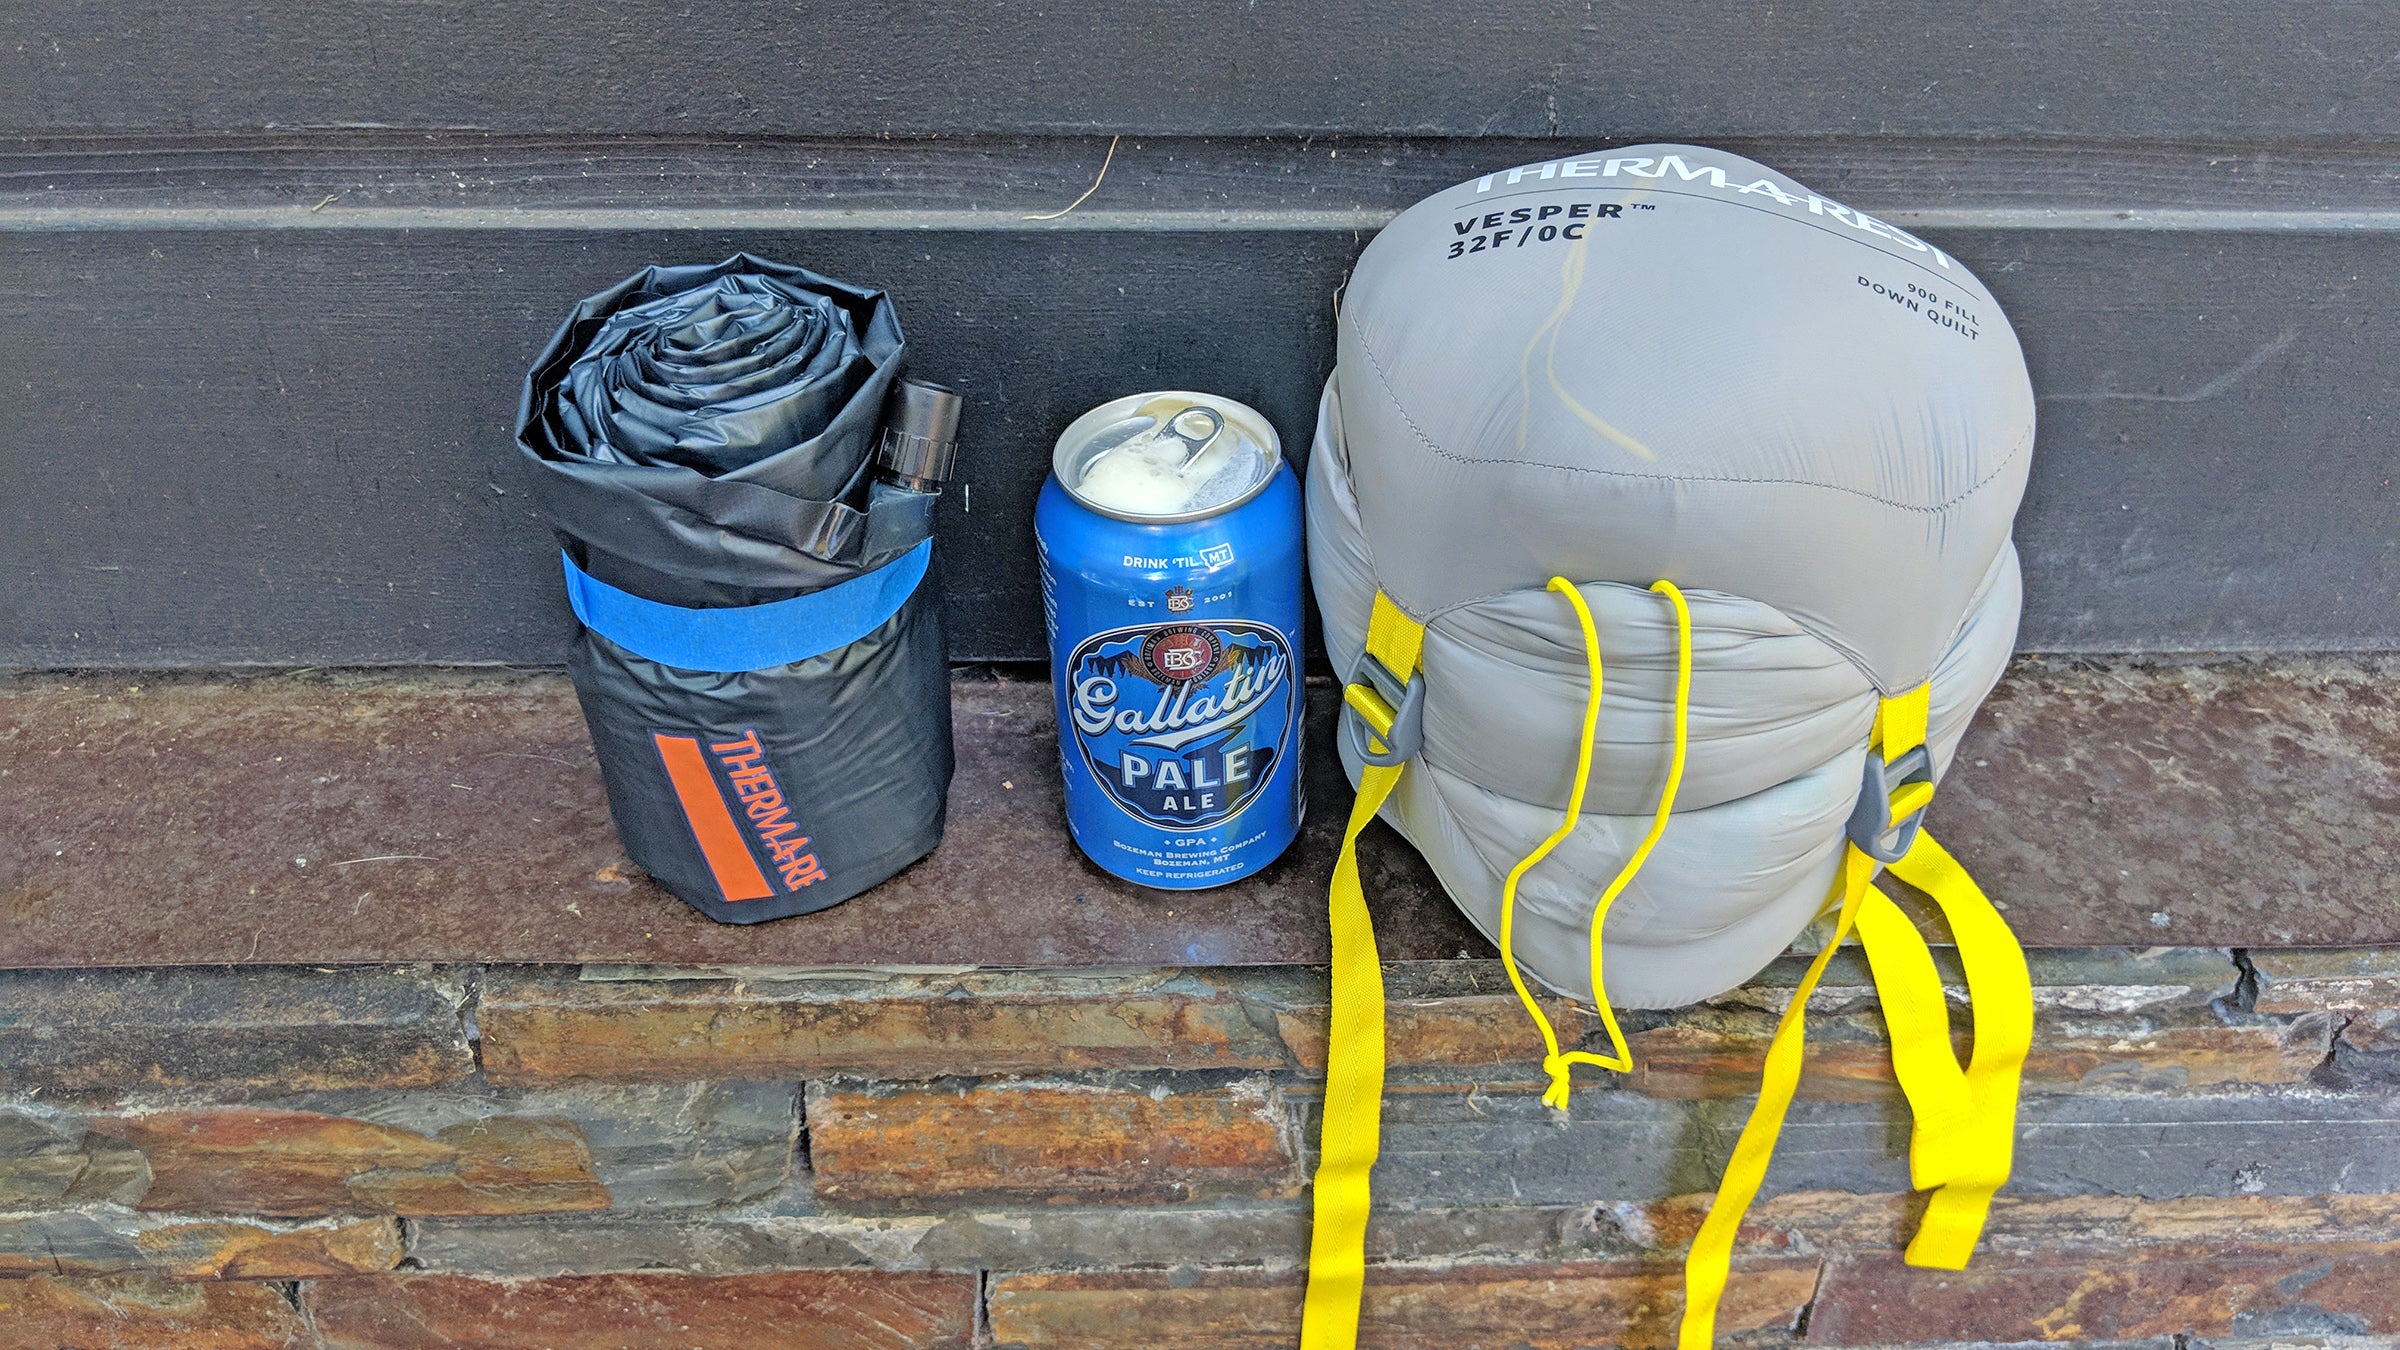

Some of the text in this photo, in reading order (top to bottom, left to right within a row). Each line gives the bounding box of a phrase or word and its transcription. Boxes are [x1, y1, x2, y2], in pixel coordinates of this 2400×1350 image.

[1448, 223, 1586, 259] 32F/0C
[1857, 275, 1979, 341] DOWN QUILT
[1907, 283, 1980, 326] 900 FILL
[1123, 555, 1168, 569] DRINK
[1207, 550, 1229, 565] MT
[1128, 591, 1233, 608] EST 2001
[1073, 653, 1288, 736] Gallatin
[1120, 742, 1251, 791] PALE
[1162, 793, 1215, 811] ALE
[1113, 830, 1267, 859] BOZEMAN BREWING COMPANY
[1175, 837, 1207, 848] GPA
[1136, 862, 1244, 879] KEEP REFRIGERATED
[1213, 854, 1230, 864] MT
